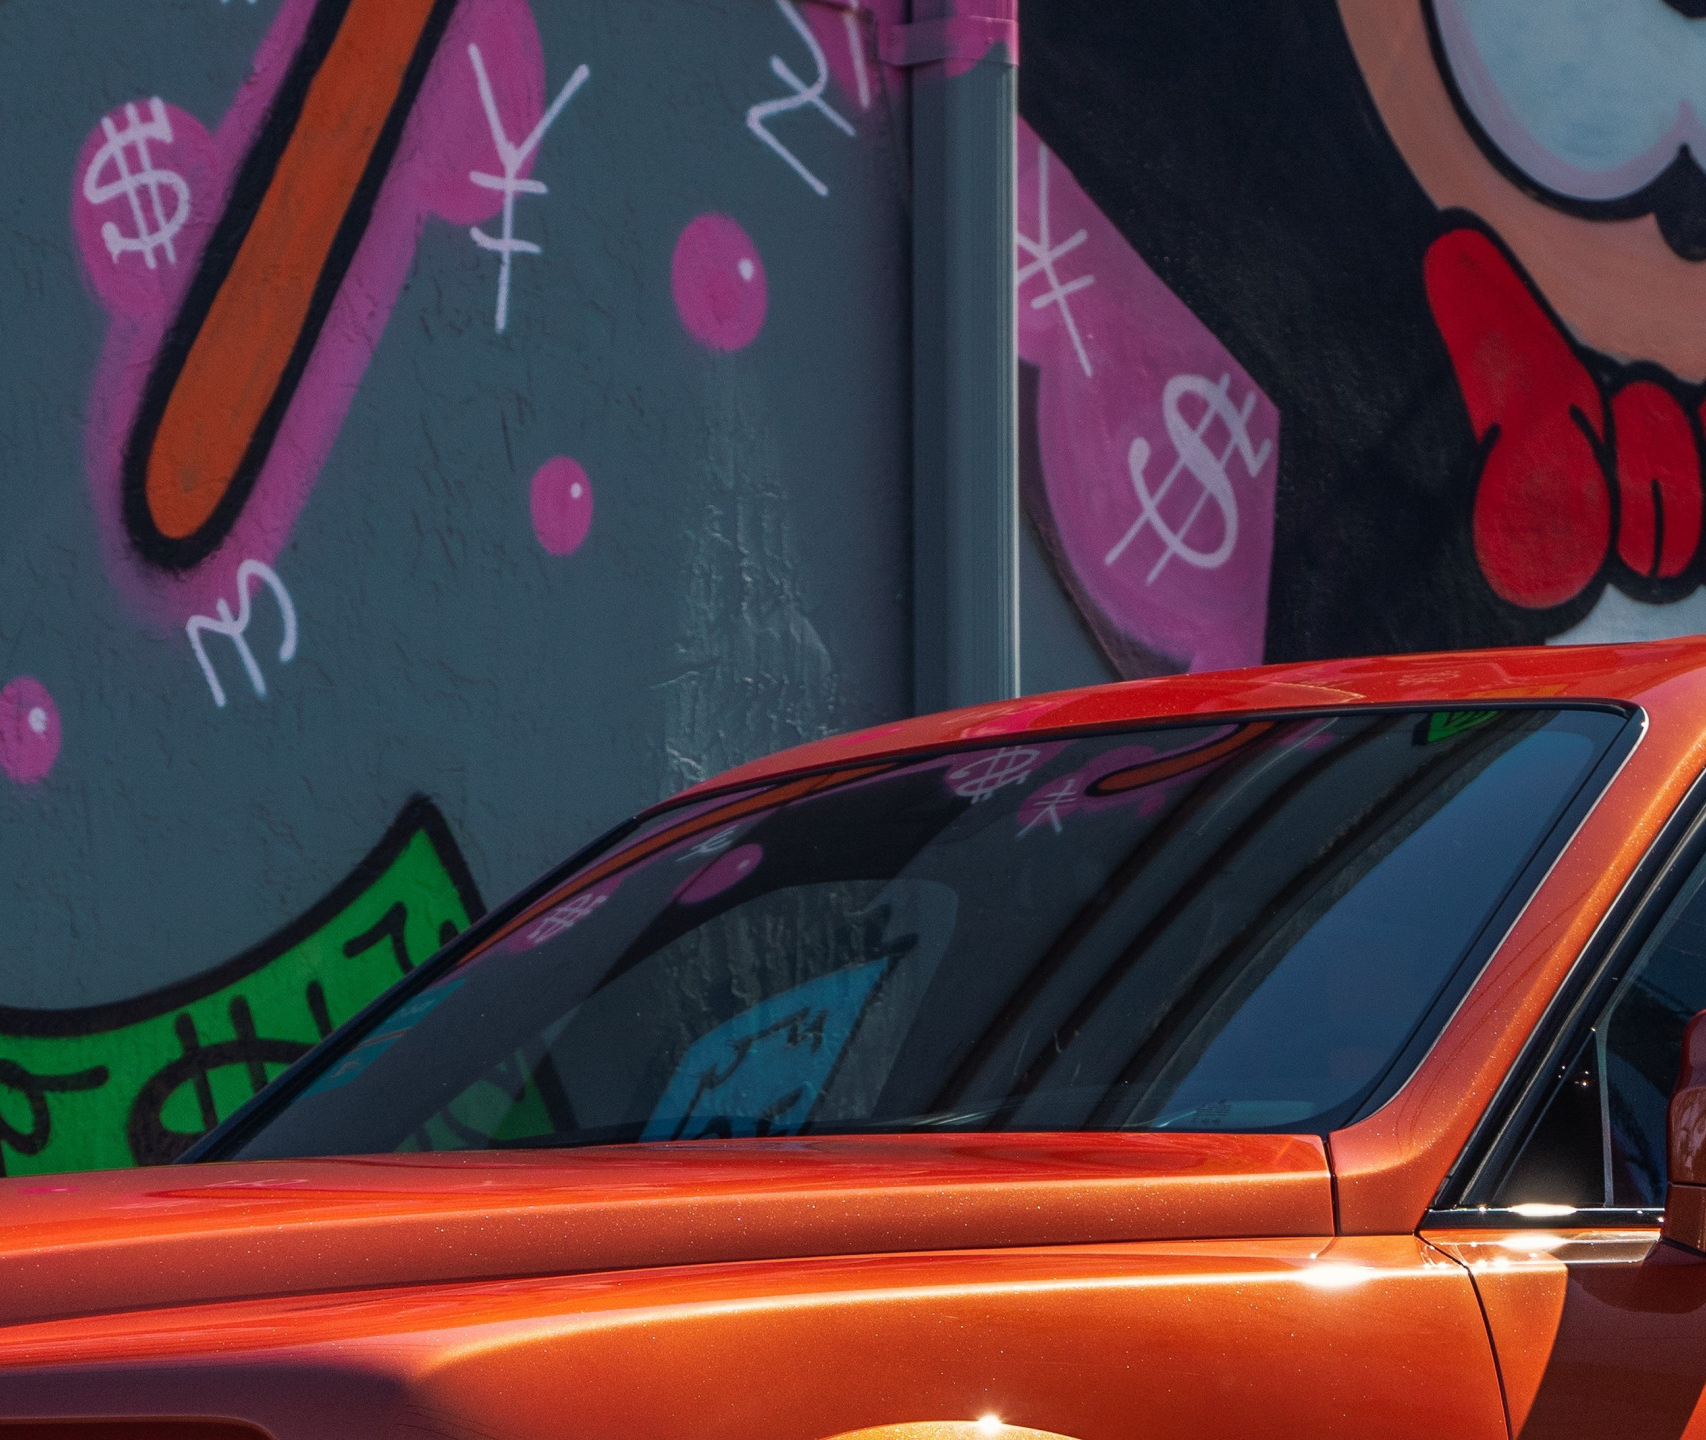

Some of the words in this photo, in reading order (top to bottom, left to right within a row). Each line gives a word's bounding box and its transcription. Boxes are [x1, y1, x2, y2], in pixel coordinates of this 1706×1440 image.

[83, 96, 191, 269] $
[467, 44, 591, 332] ¥
[1104, 373, 1273, 586] $
